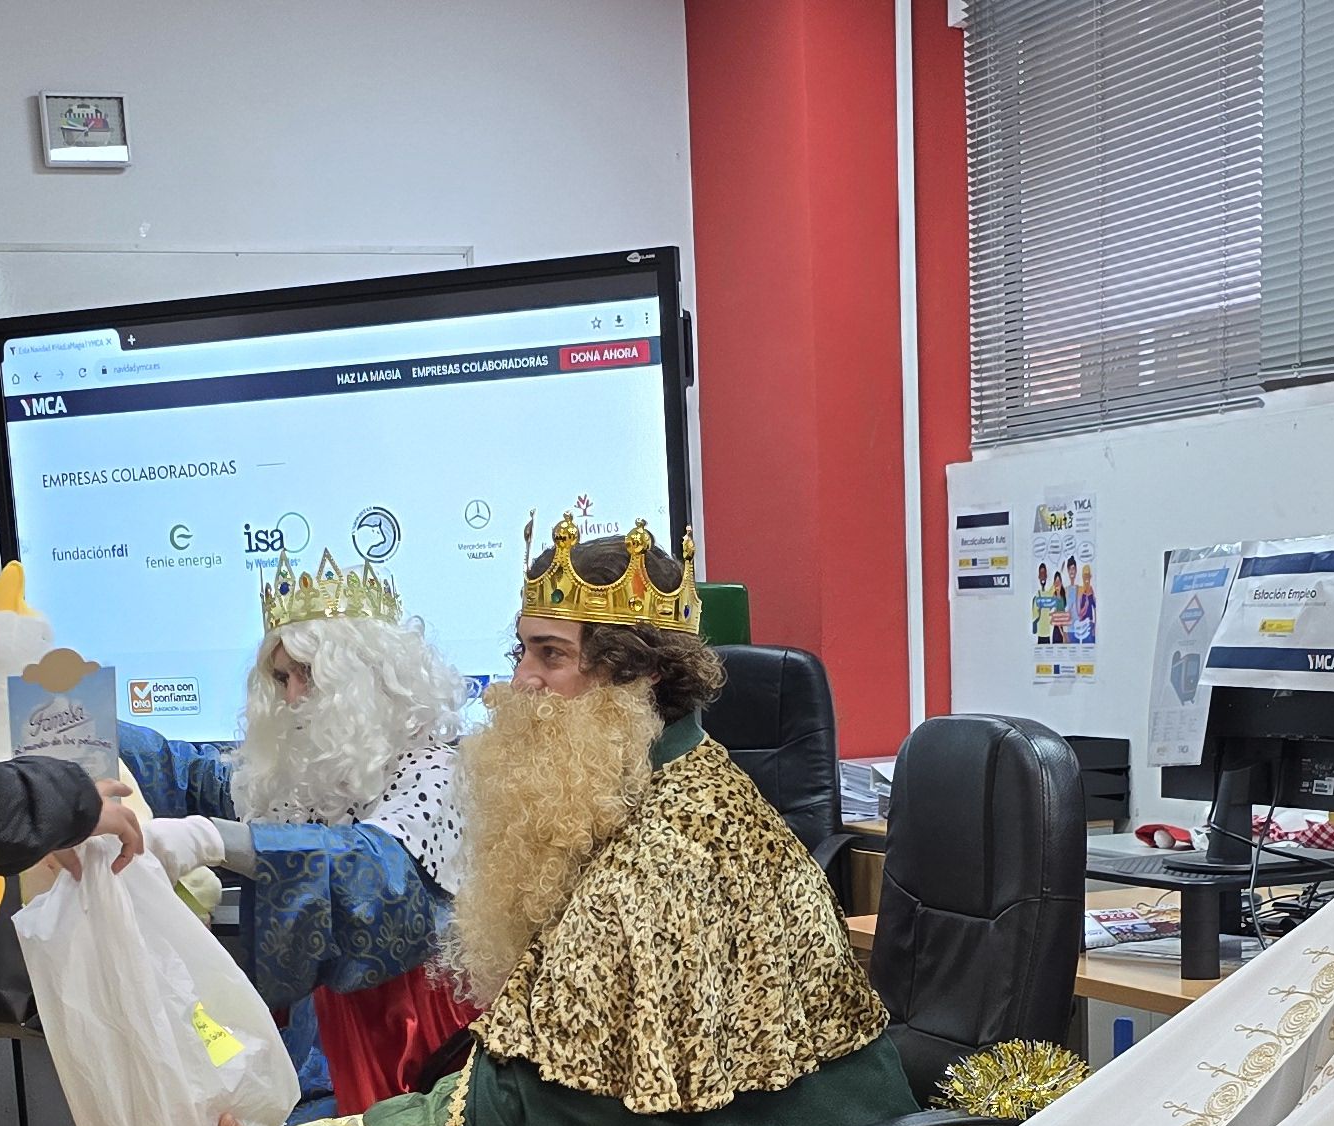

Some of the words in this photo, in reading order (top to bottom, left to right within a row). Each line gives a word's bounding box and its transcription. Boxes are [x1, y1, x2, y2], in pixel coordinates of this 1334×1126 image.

[570, 350, 601, 364] DONA
[602, 346, 639, 360] AHORA
[412, 363, 460, 379] EMPRESAS
[462, 355, 549, 374] COLABORADORAS
[336, 372, 355, 386] HAZ
[357, 371, 369, 383] LA
[370, 368, 402, 382] MAGIA
[20, 395, 68, 417] YMCA
[42, 470, 108, 488] EMPRESAS
[111, 460, 237, 483] COLABORADORAS
[244, 523, 287, 553] isa
[146, 556, 175, 569] fenie
[1253, 588, 1287, 601] Estación
[1287, 588, 1317, 600] Empleo
[152, 682, 175, 692] dona
[177, 683, 194, 691] con
[153, 693, 198, 702] confianza
